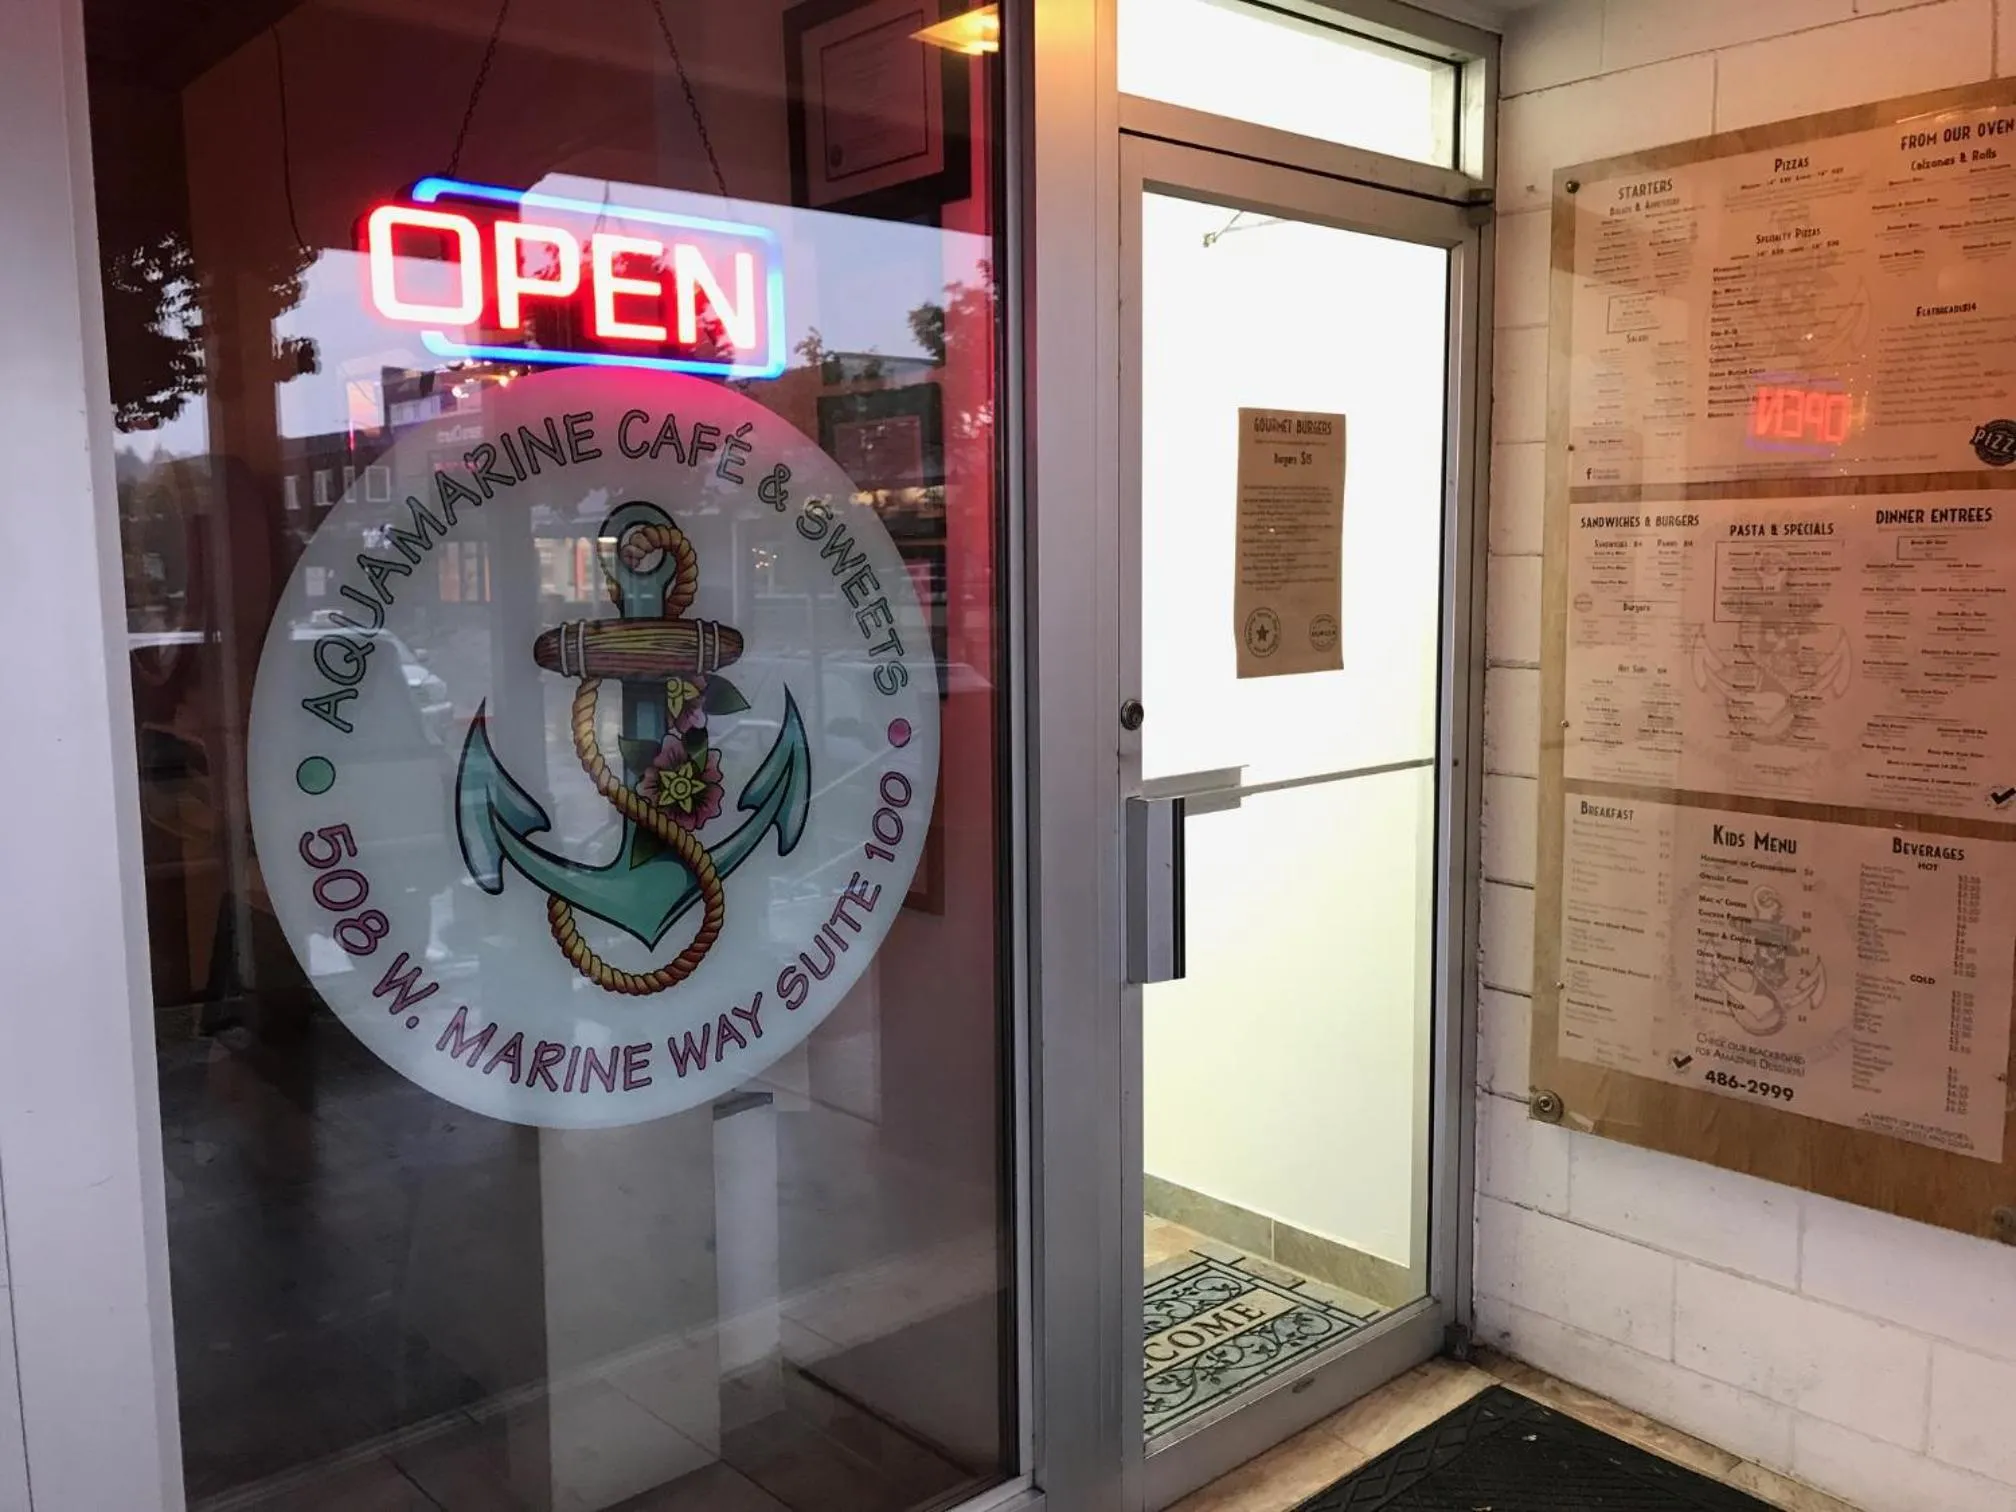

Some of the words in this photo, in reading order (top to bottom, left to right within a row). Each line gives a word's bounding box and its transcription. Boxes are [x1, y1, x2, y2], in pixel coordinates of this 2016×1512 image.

[1900, 132, 1938, 150] FROM
[1943, 125, 1971, 142] OUR
[1618, 179, 1673, 200] STARTERS
[368, 205, 757, 350] OPEN
[1254, 417, 1292, 434] GOURMET
[1297, 419, 1332, 435] BURGERS
[1974, 429, 2016, 456] PIZZ
[1581, 516, 1640, 528] SANDWICHES
[1645, 517, 1651, 527] &
[1656, 515, 1700, 527] BURGERS
[1876, 509, 1925, 524] DINNER
[1931, 507, 1993, 523] ENTREES
[1730, 524, 1765, 536] PASTA
[1771, 524, 1778, 536] &
[1784, 522, 1834, 536] SPECIALS
[302, 411, 602, 734] AQUAMARINE
[618, 409, 752, 486] CAFÉ
[758, 463, 792, 512] &
[796, 500, 909, 697] SWEETS
[1918, 862, 1938, 871] HOT
[299, 822, 391, 957] 508
[371, 953, 438, 1029] W.
[436, 1006, 653, 1095] MARINE
[669, 993, 764, 1078] WAY
[776, 872, 883, 1011] SUITE
[865, 771, 913, 863] 100
[1910, 974, 1936, 985] COLD
[1705, 1070, 1795, 1101] 486-2999
[1144, 1302, 1265, 1368] COME
